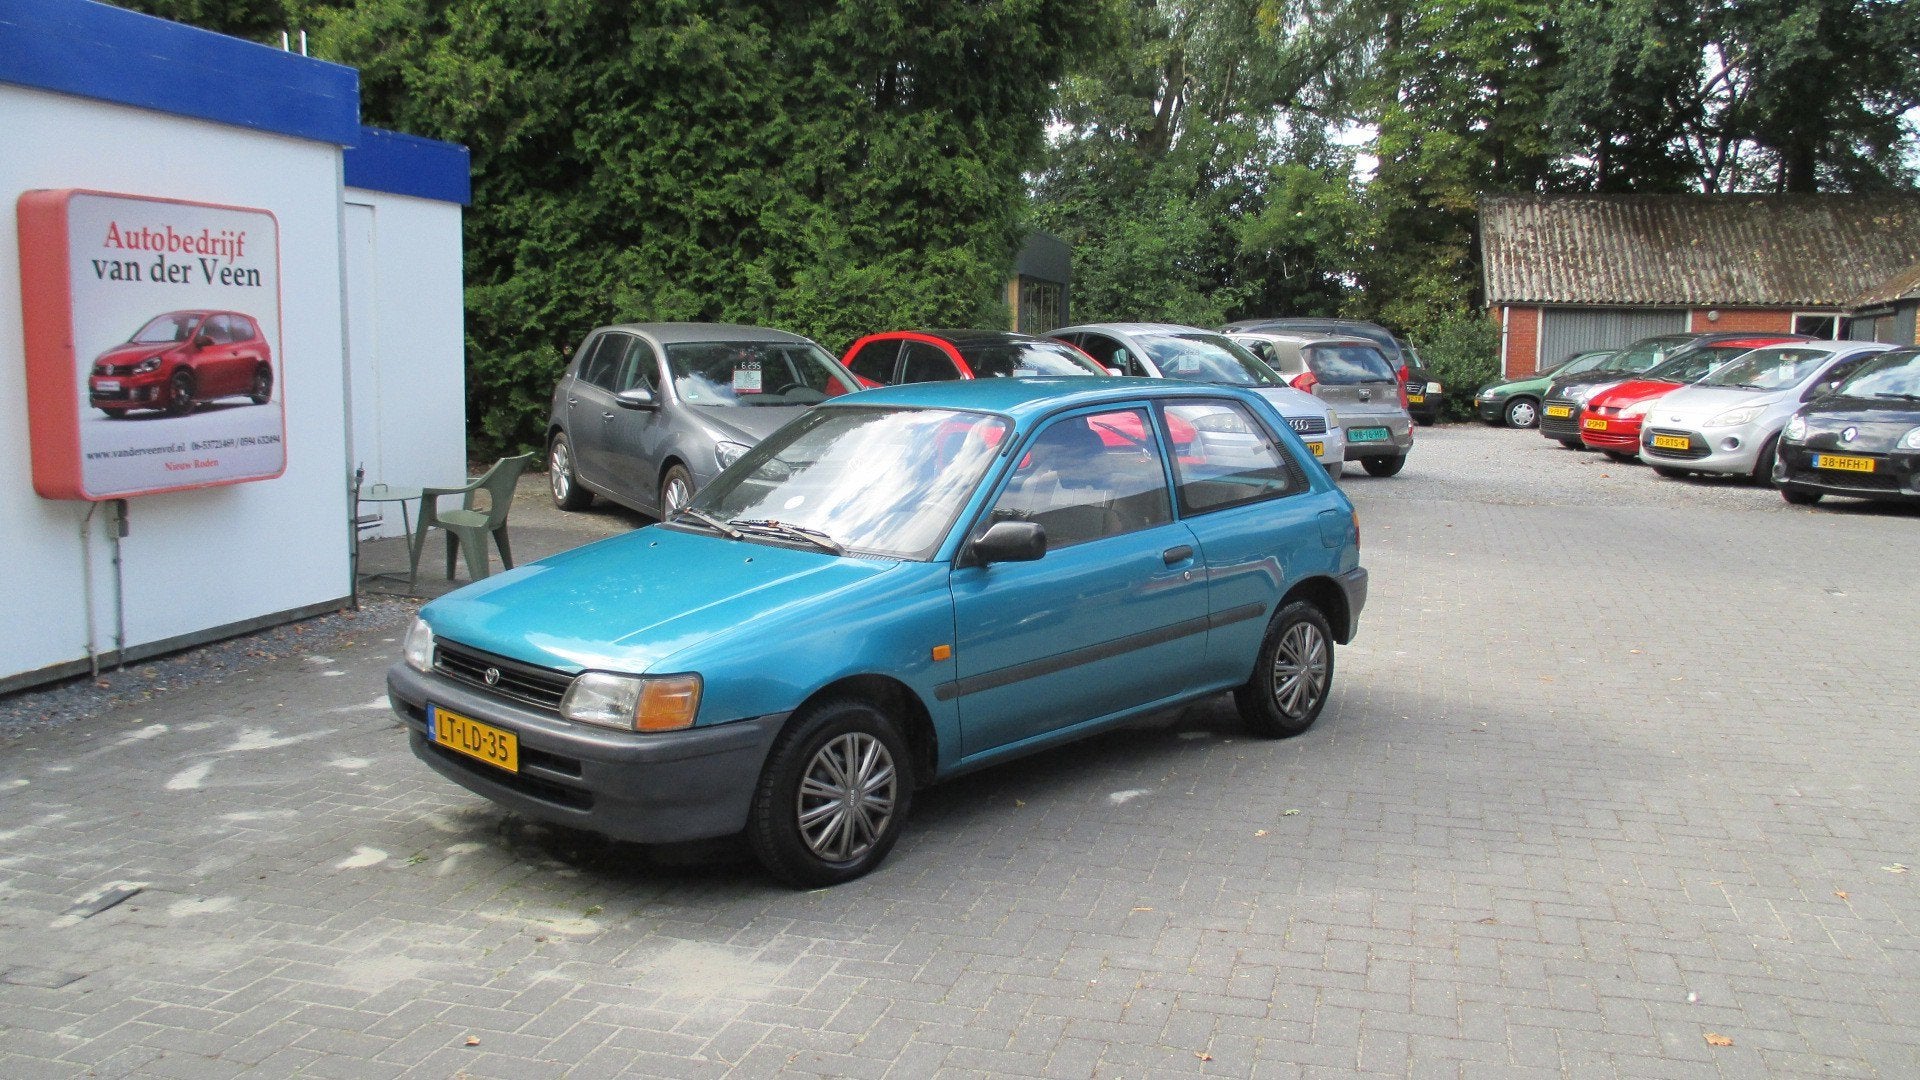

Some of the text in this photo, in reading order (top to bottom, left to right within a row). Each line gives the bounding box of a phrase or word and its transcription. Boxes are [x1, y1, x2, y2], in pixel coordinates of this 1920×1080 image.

[103, 220, 246, 265] Autobedrijf
[92, 254, 262, 287] van der Veen
[164, 458, 219, 472] Nieuw Roden
[1821, 456, 1868, 470] 38-HFH-1
[438, 712, 509, 762] LT-LD-35
